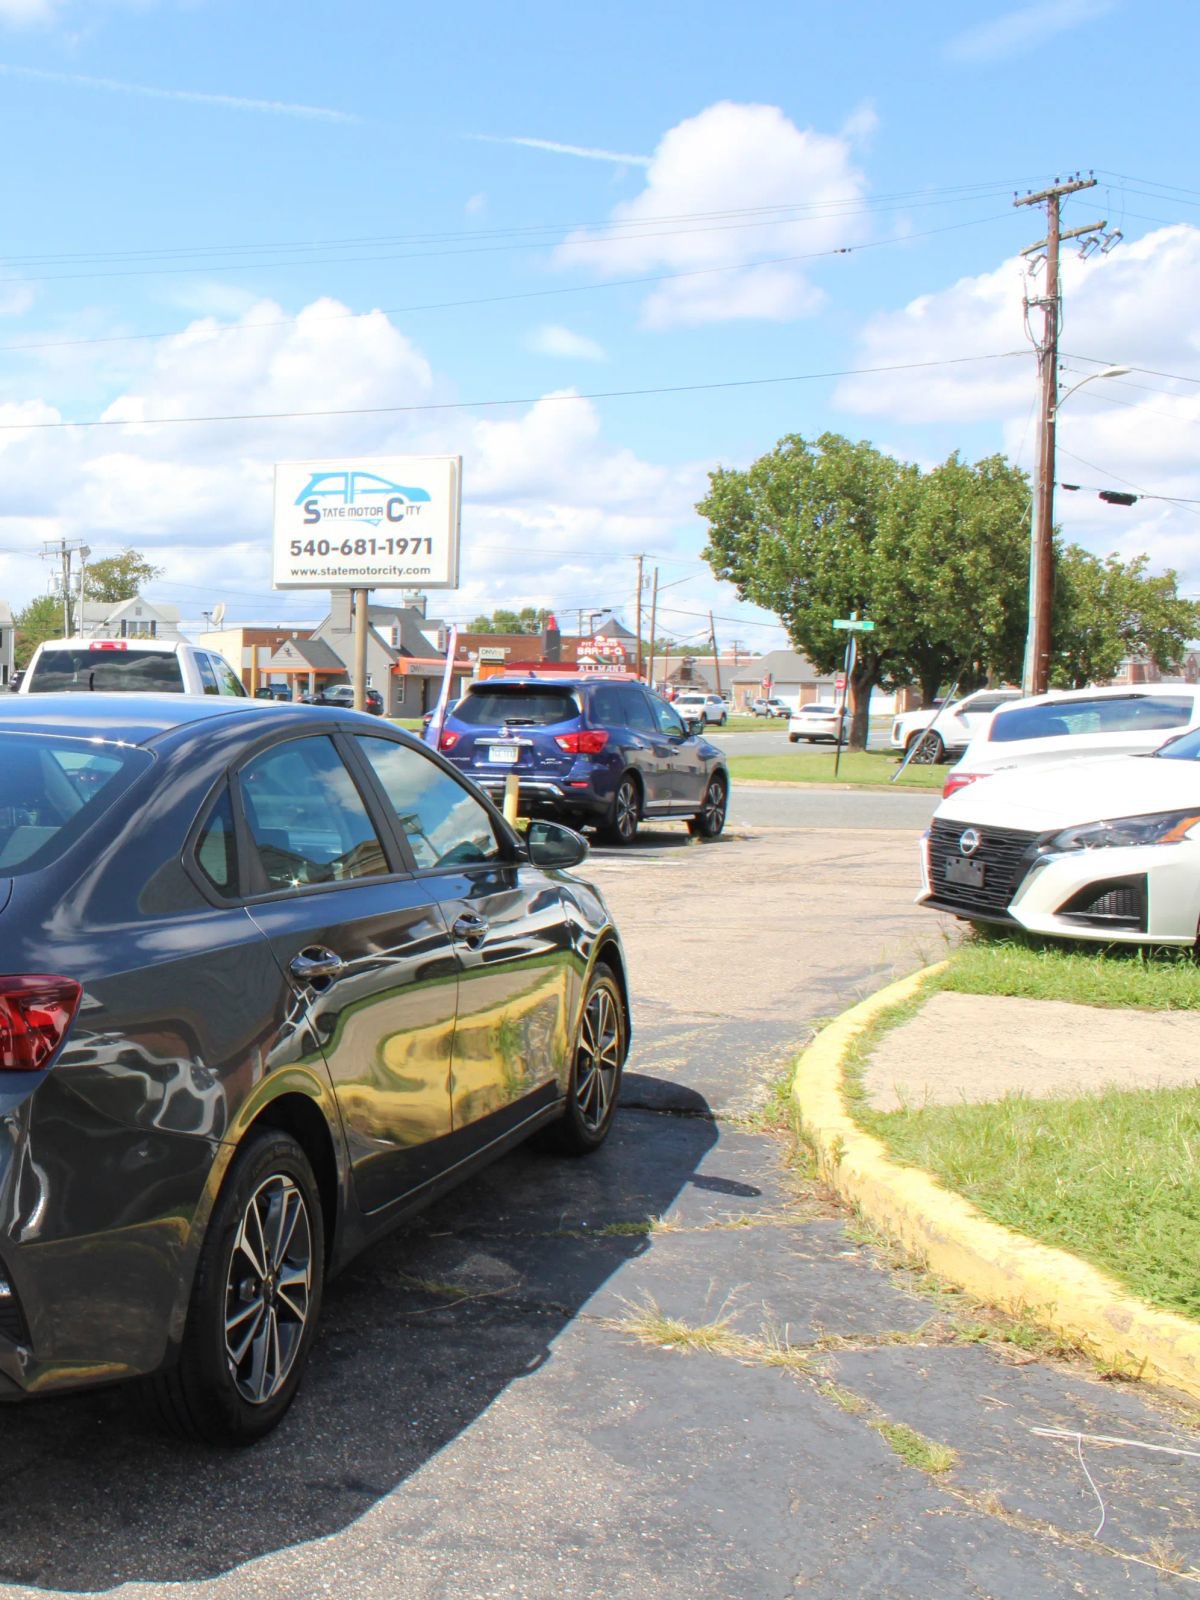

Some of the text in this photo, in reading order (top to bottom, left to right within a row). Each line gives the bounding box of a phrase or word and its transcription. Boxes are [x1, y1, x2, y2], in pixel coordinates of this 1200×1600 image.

[304, 497, 421, 524] STATE MOTOR CITY
[290, 538, 432, 556] 540-681-1971
[290, 565, 431, 577] www.statemotorcity.com
[577, 646, 623, 656] BAR-B-Q
